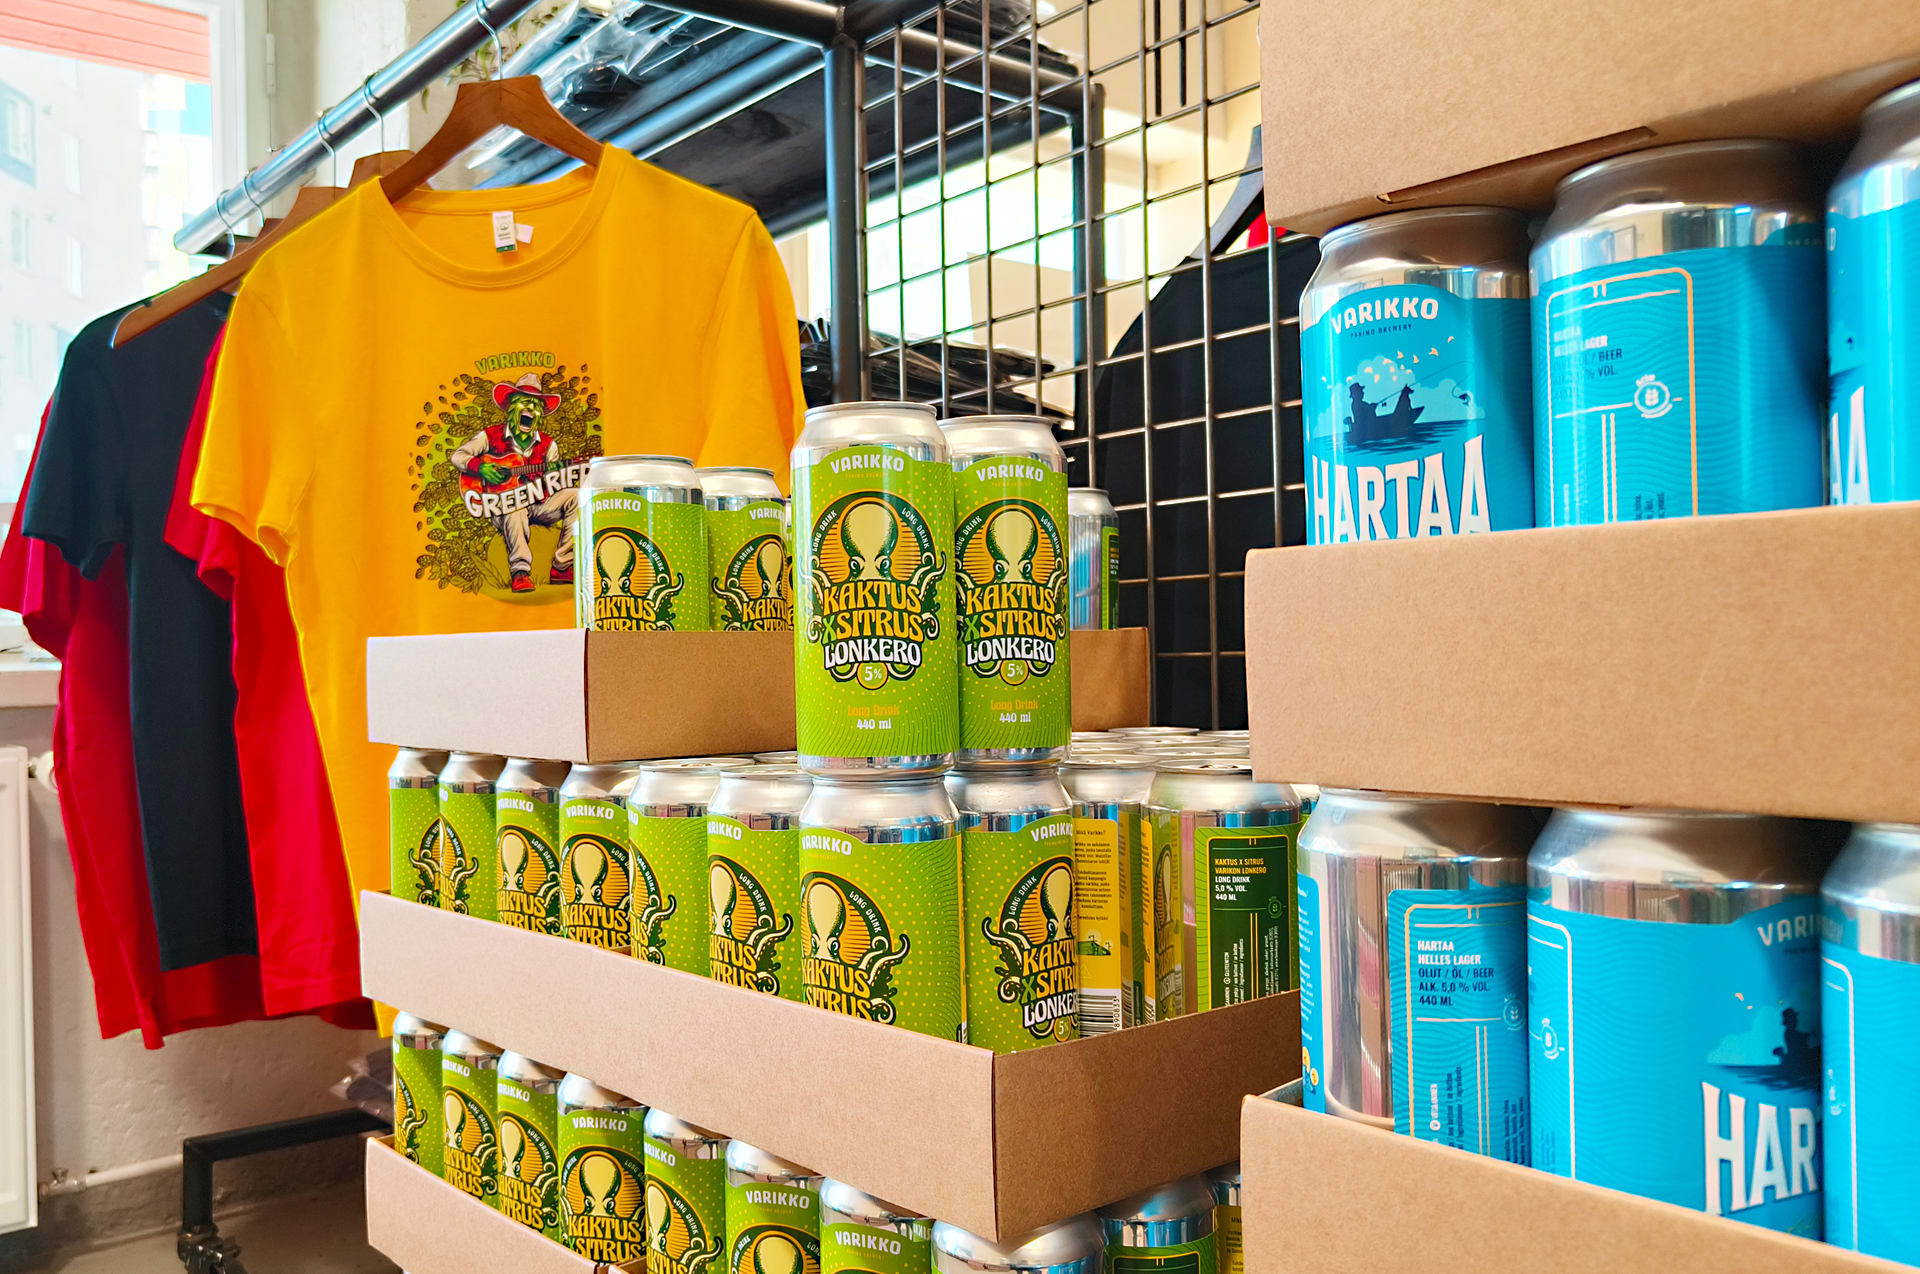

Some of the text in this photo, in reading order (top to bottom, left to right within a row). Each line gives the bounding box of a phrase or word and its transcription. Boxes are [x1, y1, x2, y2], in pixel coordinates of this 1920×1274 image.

[1332, 297, 1438, 335] VARIKKO
[475, 351, 555, 374] VARIKKO
[1598, 348, 1622, 362] BEER
[830, 454, 904, 474] VARIKKO
[976, 464, 1044, 482] VARIKKO
[464, 476, 546, 518] GREEN
[1312, 434, 1492, 545] HARTAA
[820, 510, 838, 532] DRINK
[901, 508, 930, 549] LONG DRINK
[964, 516, 982, 535] DRINK
[595, 596, 656, 622] AKTUS
[824, 581, 922, 616] KAKTUS
[966, 583, 1056, 616] KAKTUS
[836, 610, 924, 642] SITRUS
[980, 610, 1056, 642] SITRUS
[824, 639, 922, 669] LONKERO
[967, 638, 1055, 665] LONKERO
[864, 666, 882, 682] 5%
[1007, 663, 1024, 677] 5%
[856, 718, 892, 730] 440 ml
[1000, 712, 1032, 722] 440 ml
[566, 804, 614, 820] VARIKKO
[802, 834, 852, 856] VARIKKO
[739, 872, 768, 912] LONG DRINK
[1008, 876, 1038, 916] LONG DRINK
[849, 890, 882, 934] LONG DRINK
[1022, 938, 1078, 977] KAKTU
[1418, 940, 1454, 952] HARTAA
[1418, 954, 1481, 965] HELLES LAGER
[1418, 968, 1441, 978] OLUT
[1452, 966, 1464, 978] ÖL
[1473, 968, 1494, 978] BEER
[1419, 982, 1439, 992] ALK.
[1442, 982, 1456, 993] 5,0
[1458, 982, 1469, 992] %
[1024, 992, 1080, 1028] LONKER
[1419, 996, 1453, 1006] 440 ML
[572, 1116, 627, 1132] VARIKKO
[746, 1190, 810, 1209] VARIKKO
[673, 1196, 699, 1235] LONG DRINK
[568, 1216, 641, 1242] KAKTUS
[835, 1231, 901, 1255] VARIKKO
